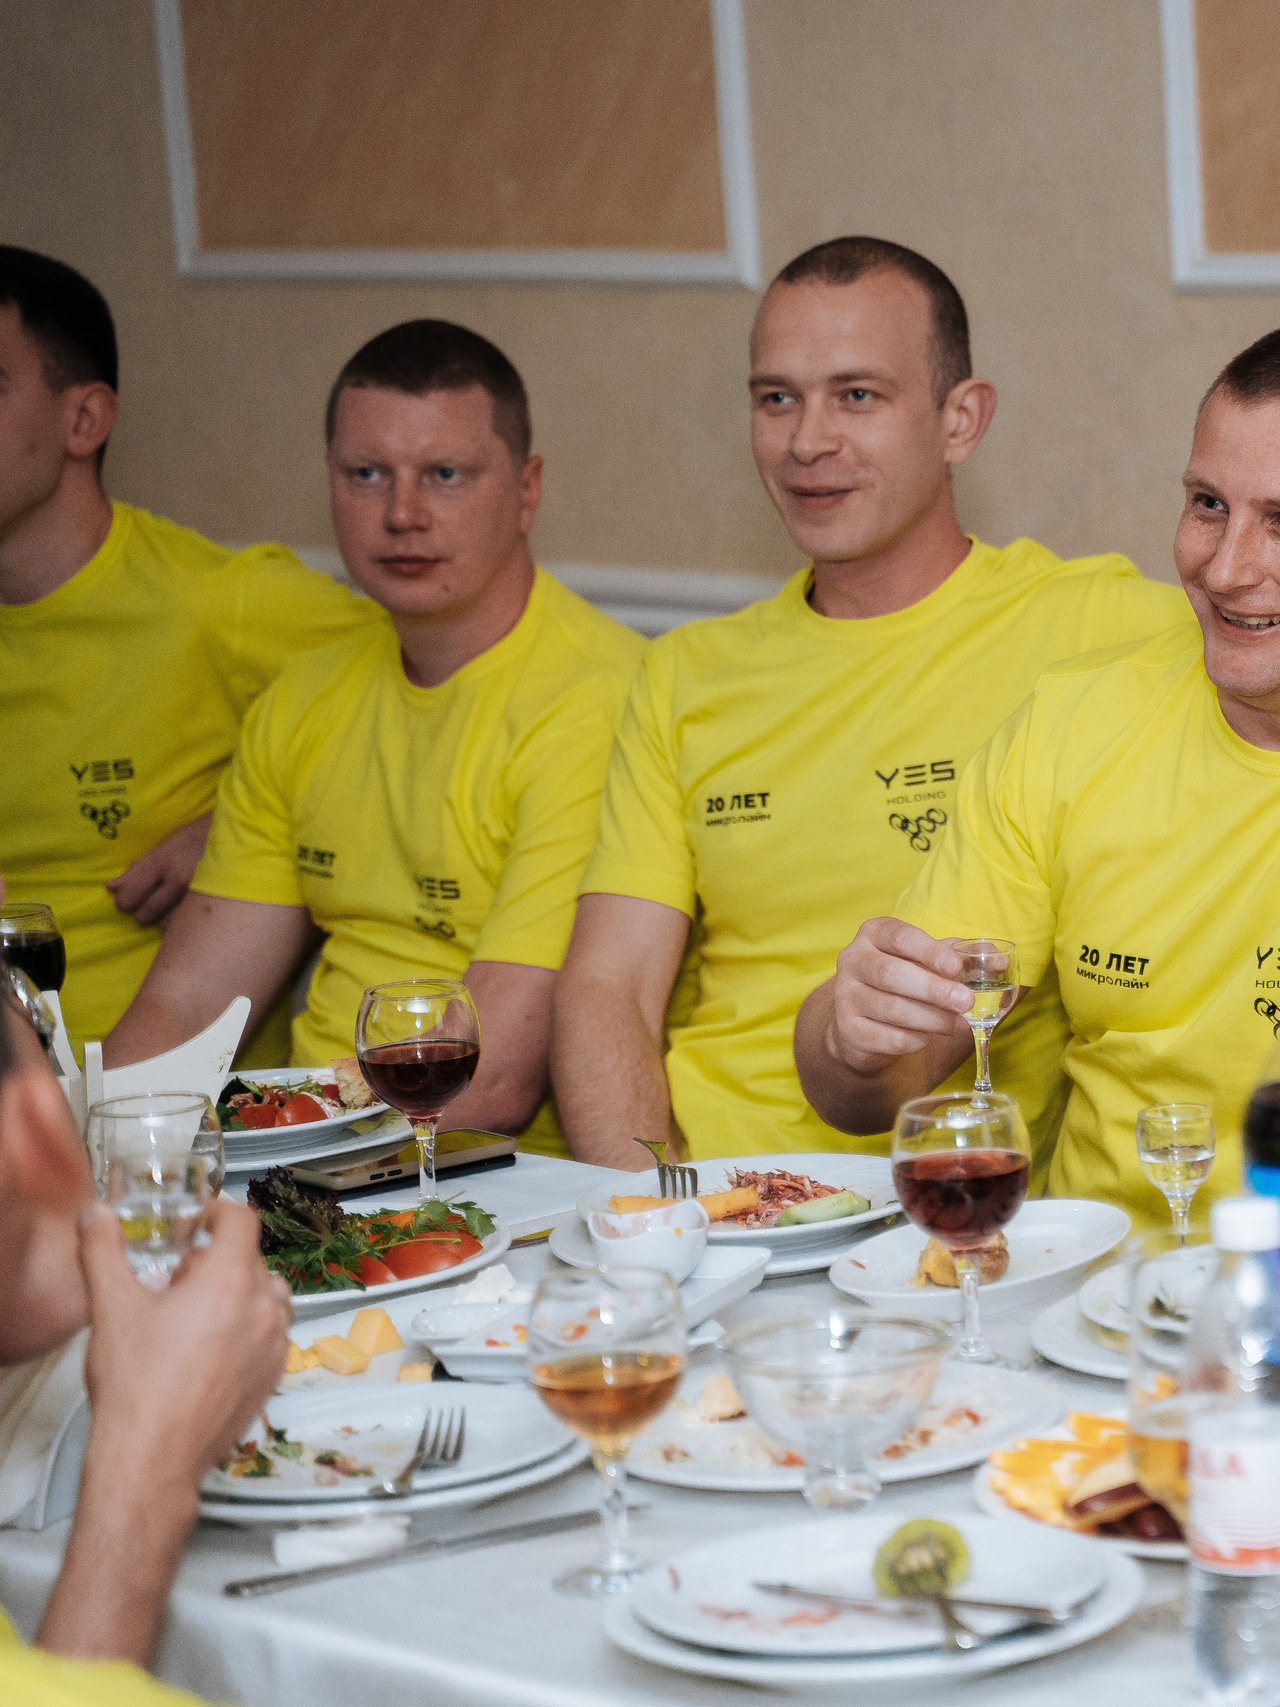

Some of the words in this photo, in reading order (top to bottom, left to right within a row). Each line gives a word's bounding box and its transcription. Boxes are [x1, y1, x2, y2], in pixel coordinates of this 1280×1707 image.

[70, 758, 134, 782] YES
[875, 760, 956, 789] YES
[707, 797, 725, 813] 20
[730, 792, 770, 810] ЛЕТ
[886, 791, 946, 805] HOLDING
[1079, 944, 1100, 967] 20
[1105, 952, 1150, 976] ЛЕТ
[1076, 967, 1150, 989] микролайн
